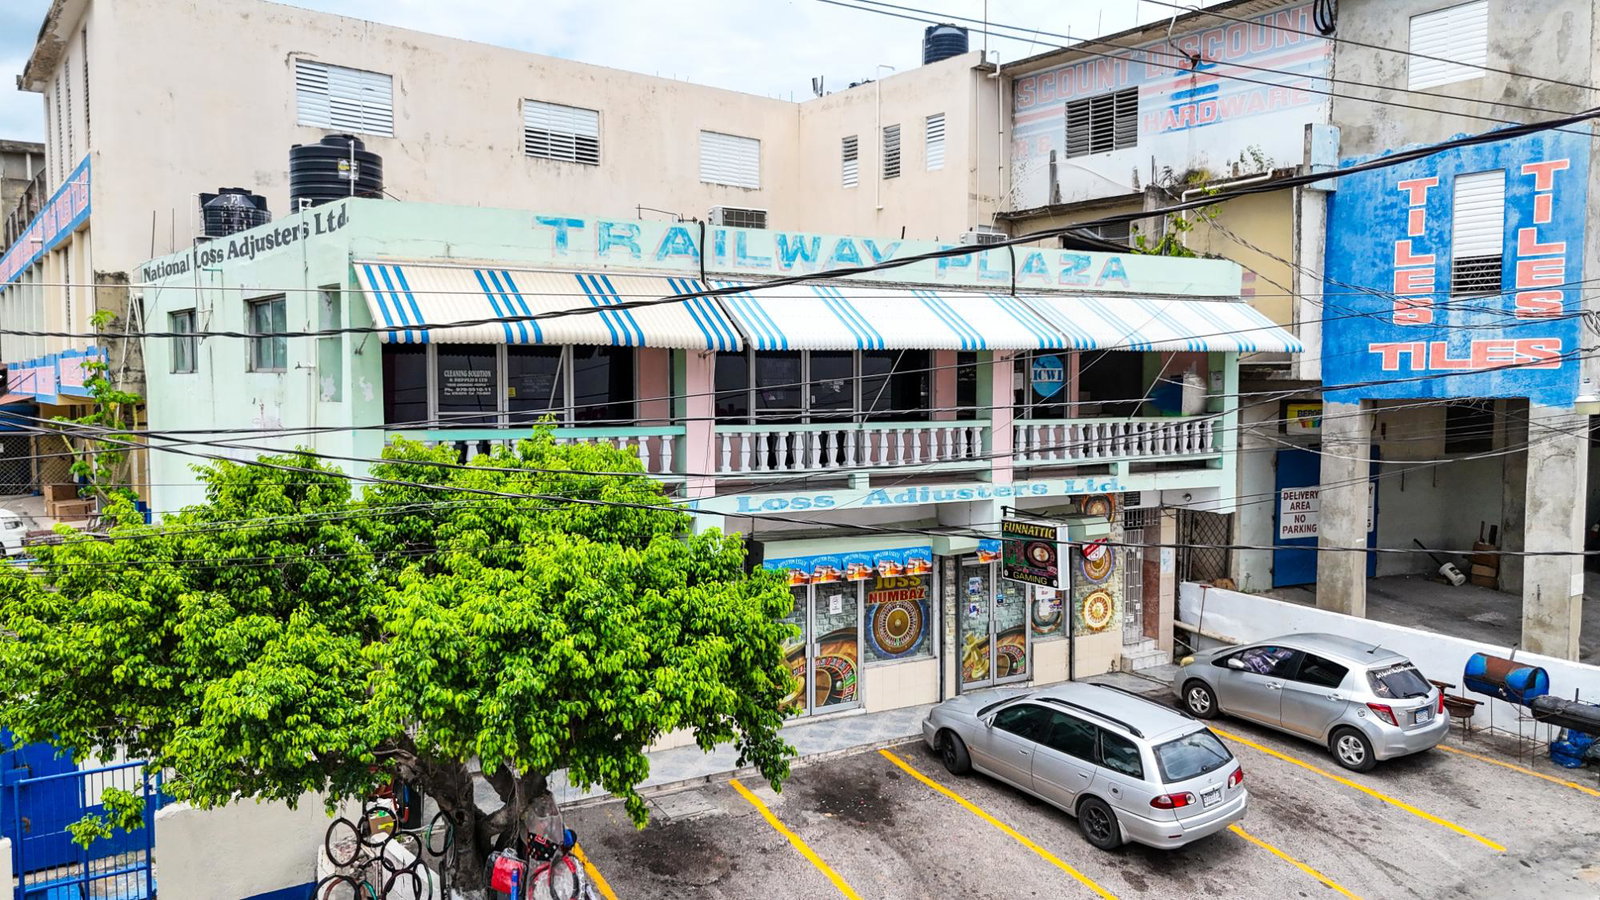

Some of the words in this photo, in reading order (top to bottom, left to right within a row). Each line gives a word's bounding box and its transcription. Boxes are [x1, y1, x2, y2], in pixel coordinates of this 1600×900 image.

[1143, 80, 1311, 133] HARDWARE
[143, 253, 190, 283] National
[194, 249, 225, 269] Loss
[227, 221, 311, 260] Adjusters
[314, 203, 349, 235] Ltd.
[1513, 158, 1570, 320] TILES
[533, 215, 901, 275] TRAILWAY
[935, 244, 1130, 288] PLAZA
[1393, 176, 1439, 325] TILES
[1368, 338, 1563, 371] TILES
[443, 370, 468, 378] CLEANING
[1033, 369, 1063, 381] ICWI
[736, 495, 836, 513] Loss
[862, 482, 1049, 505] Adjusters
[1064, 478, 1127, 494] Ltd.
[1283, 490, 1320, 501] DELIVERY
[1290, 502, 1311, 511] AREA
[1294, 514, 1306, 523] NO
[1003, 521, 1056, 539] FUNNATTIC
[1282, 524, 1317, 534] PARKING
[1013, 571, 1048, 585] GAMING
[868, 587, 925, 605] NUMBAZ
